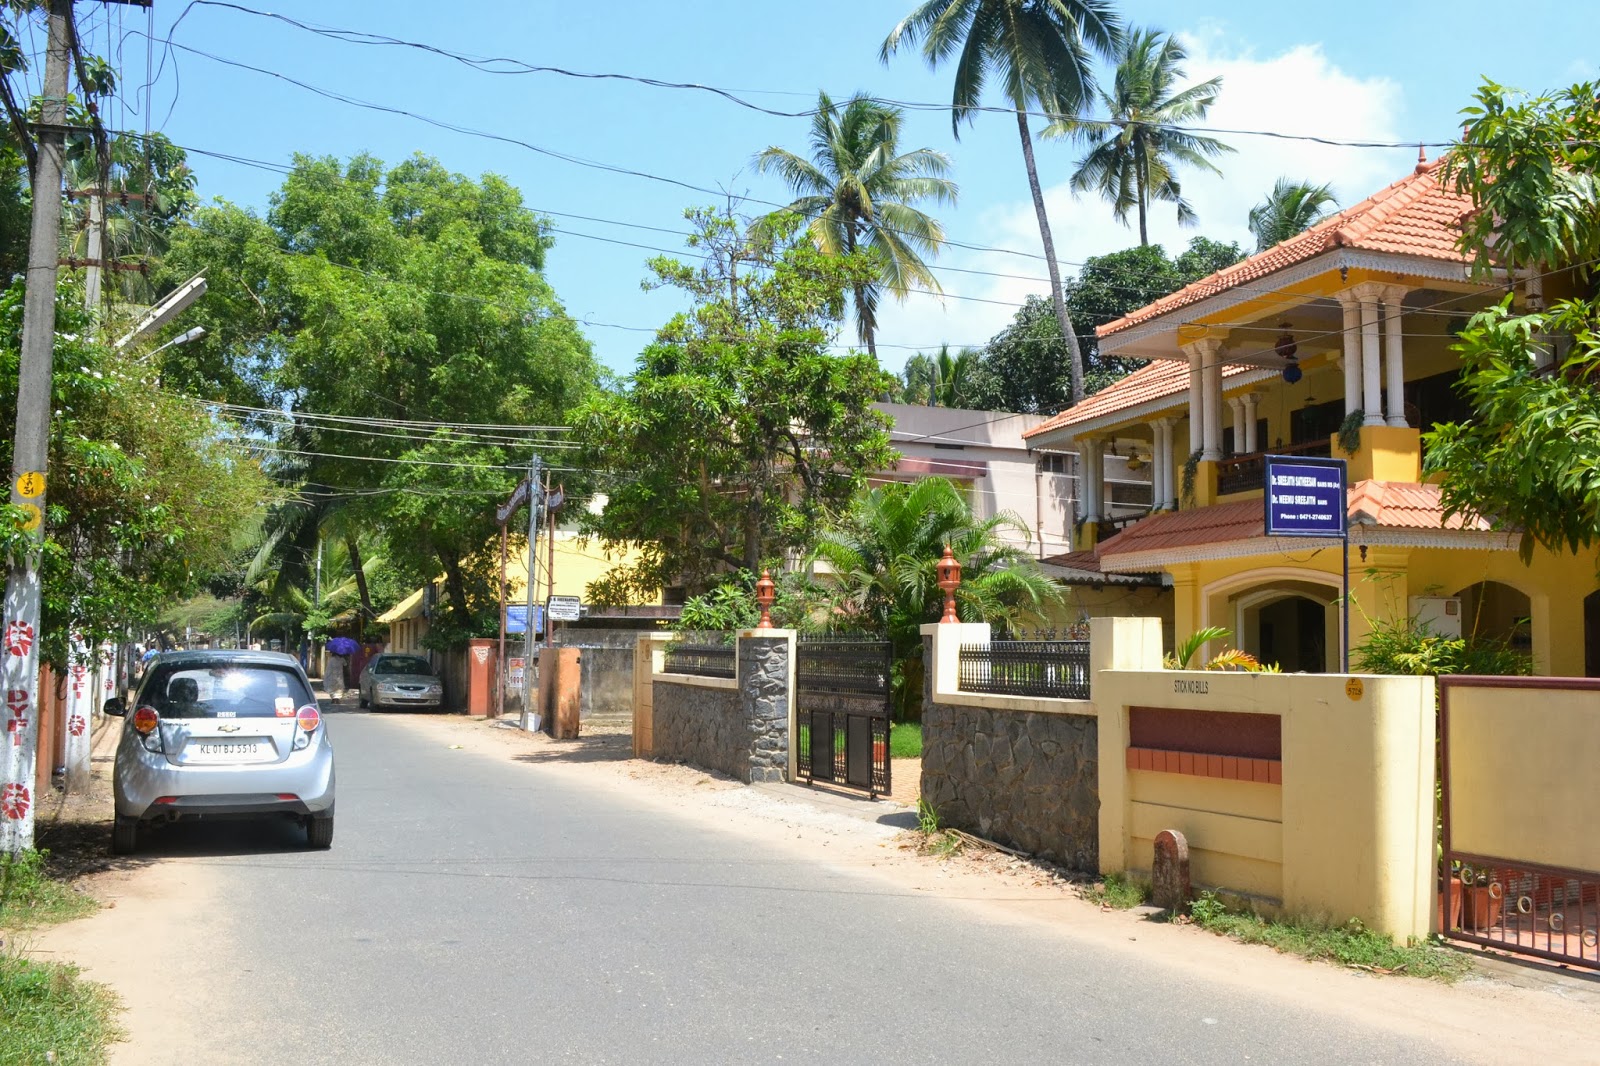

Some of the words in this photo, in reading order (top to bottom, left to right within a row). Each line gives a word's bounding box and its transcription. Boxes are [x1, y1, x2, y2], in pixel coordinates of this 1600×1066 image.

[1174, 680, 1187, 693] STICK
[1188, 680, 1194, 694] NO
[1195, 680, 1209, 695] BILLS
[200, 744, 210, 754] KL
[224, 744, 234, 754] BJ
[237, 743, 257, 754] 5513
